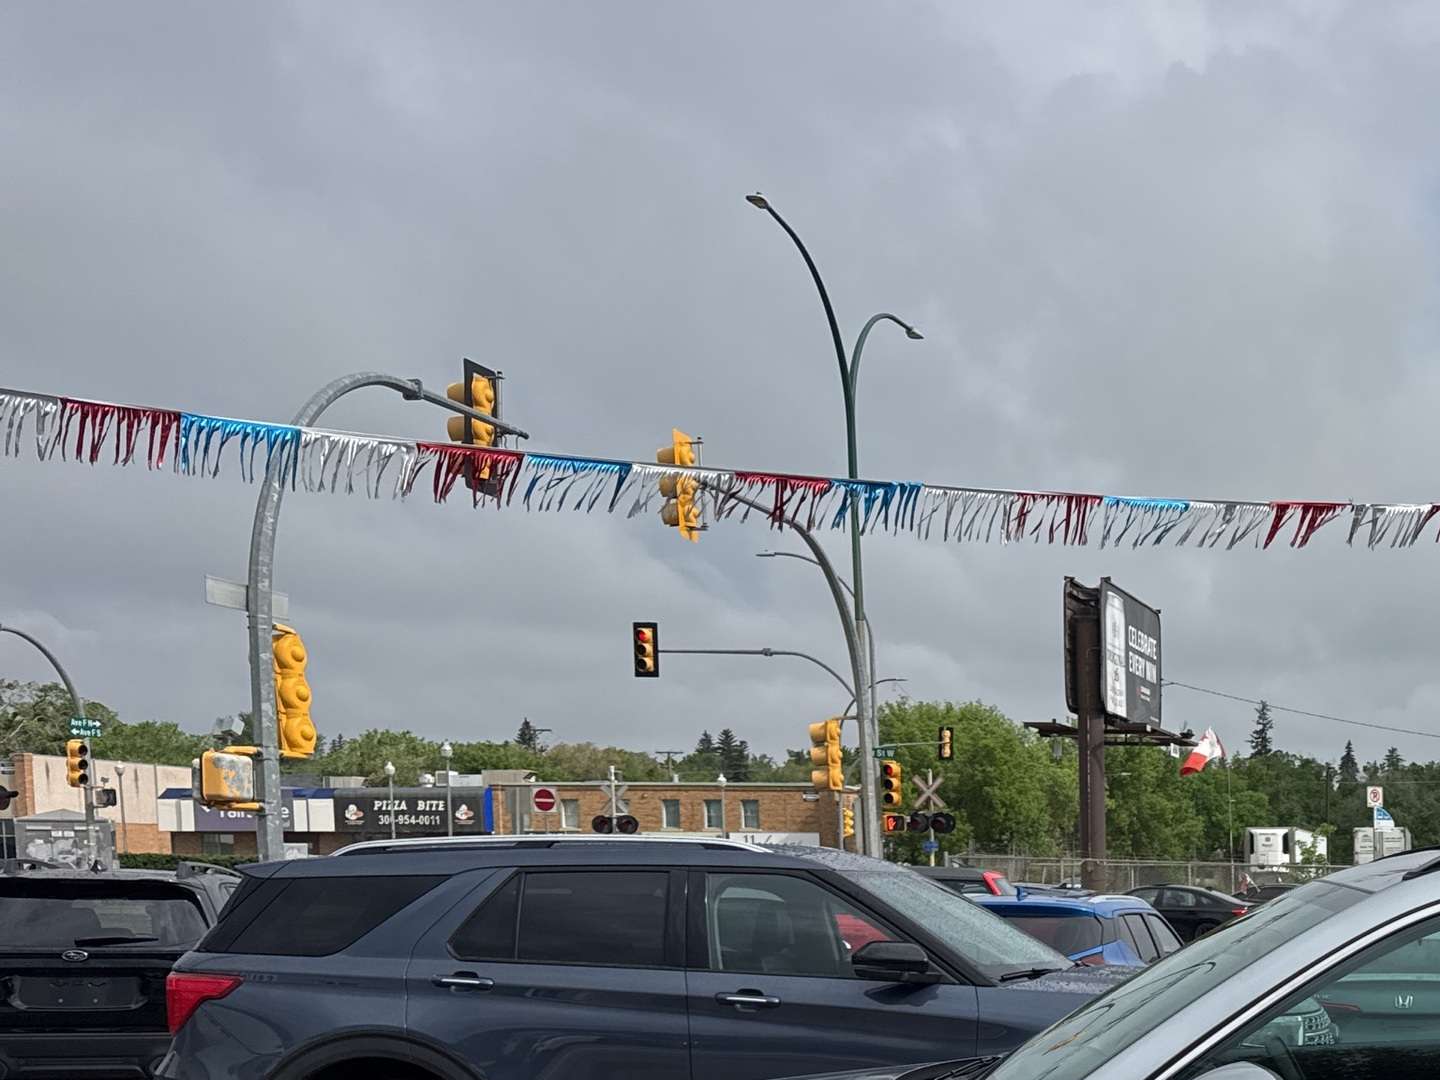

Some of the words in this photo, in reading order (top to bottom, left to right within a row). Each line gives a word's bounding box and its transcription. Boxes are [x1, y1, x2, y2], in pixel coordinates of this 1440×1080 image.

[1128, 625, 1157, 660] CELEBRATE
[1128, 651, 1145, 678] EVERY
[373, 800, 407, 810] PIZZA
[417, 800, 446, 810] BITE
[378, 814, 441, 825] 30-954-0011
